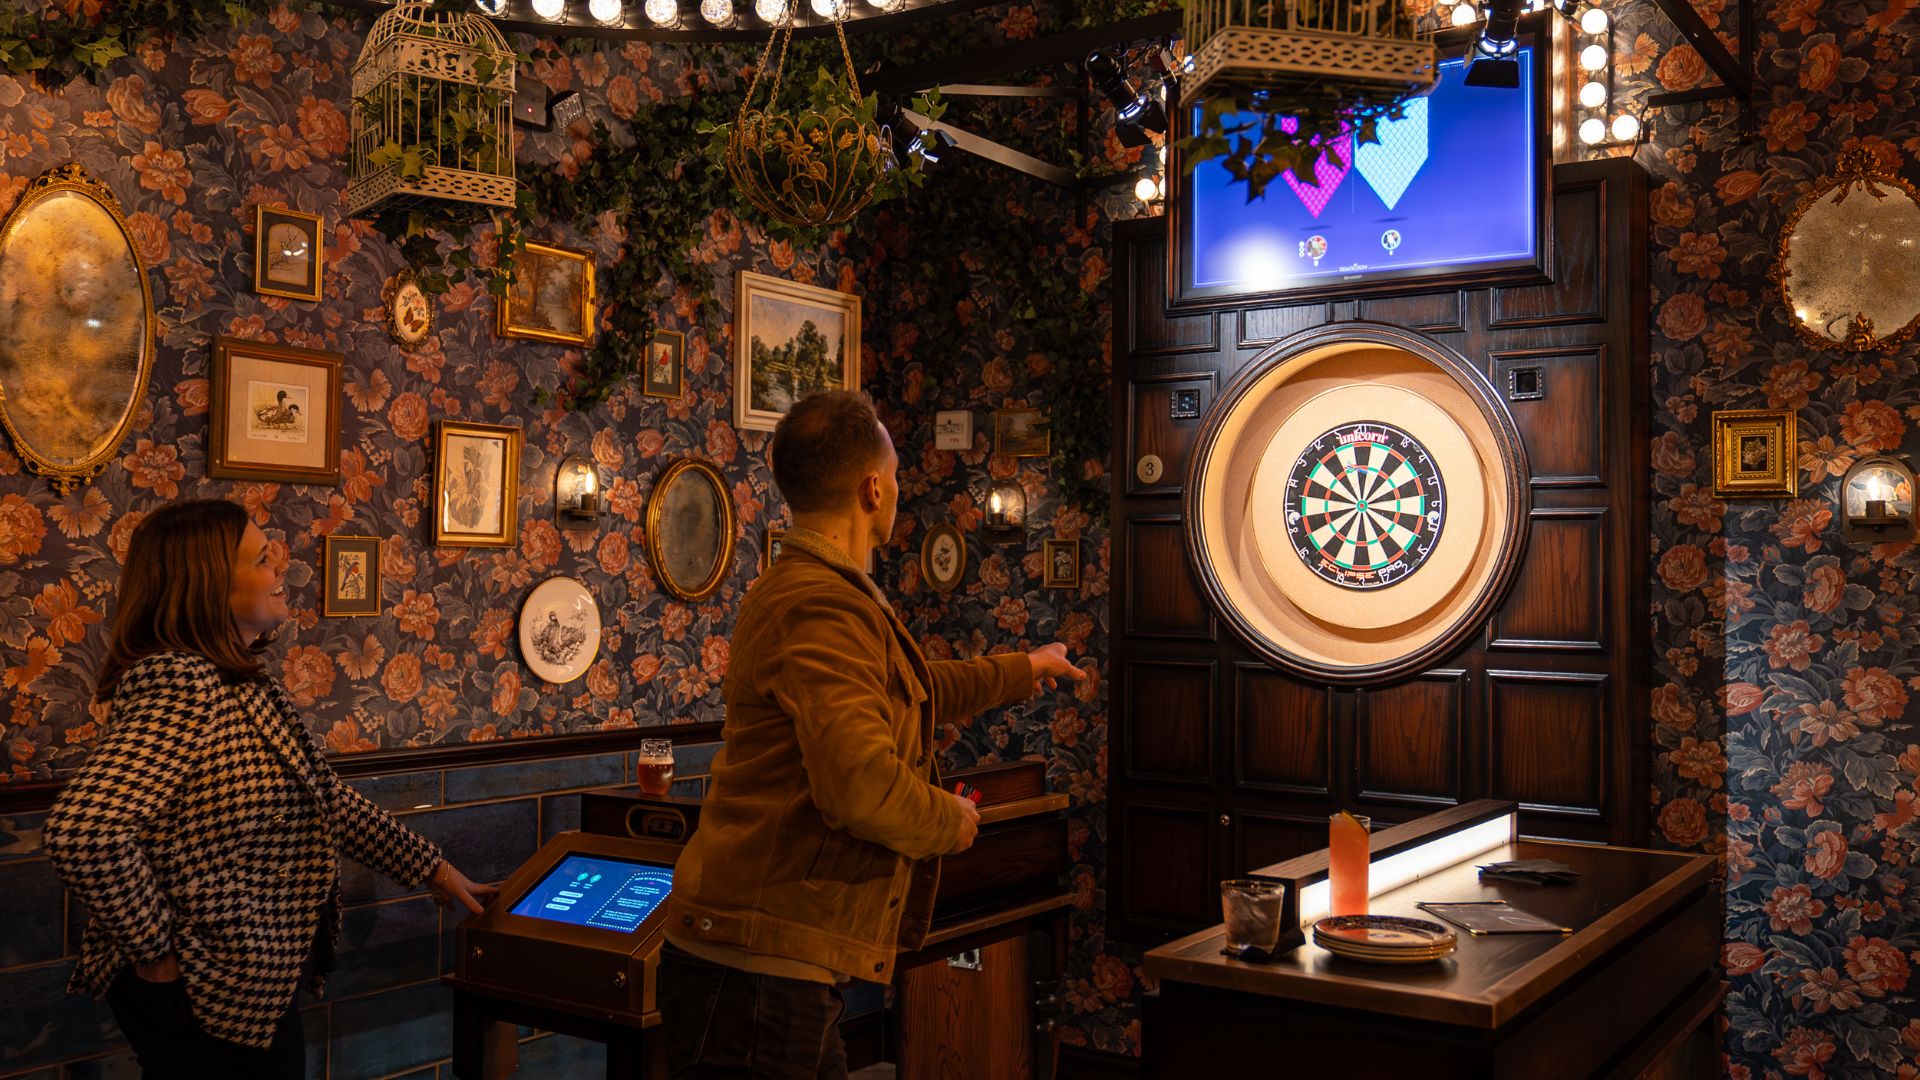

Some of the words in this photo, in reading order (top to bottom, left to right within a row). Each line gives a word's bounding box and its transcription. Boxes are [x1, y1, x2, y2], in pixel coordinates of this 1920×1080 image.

[1354, 424, 1367, 434] 20
[1339, 430, 1387, 445] unicorn
[1400, 436, 1411, 448] 18
[1313, 440, 1325, 451] 12
[1418, 454, 1427, 464] 4
[1145, 462, 1154, 477] 3
[1288, 478, 1299, 488] 14
[1299, 546, 1310, 560] 16
[1320, 558, 1375, 580] ECLIPSE
[1377, 559, 1403, 578] PRO
[1336, 573, 1345, 585] 19
